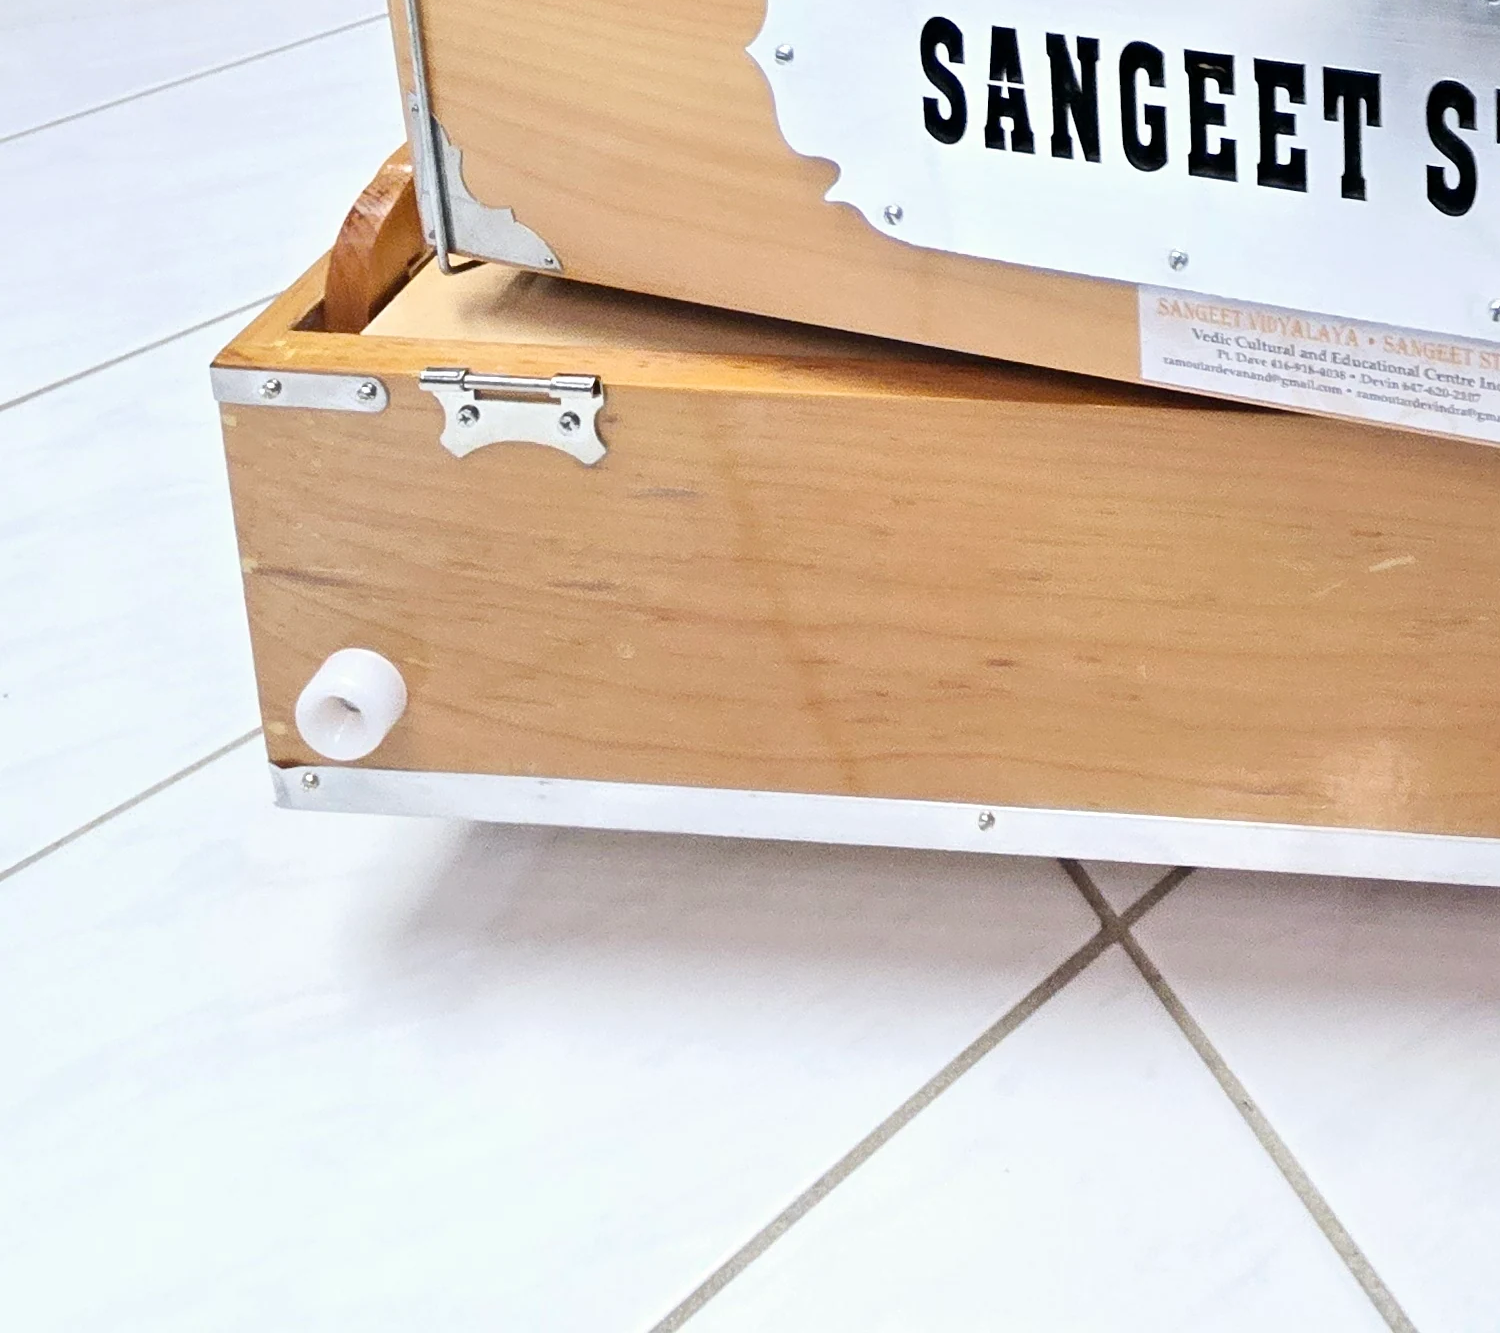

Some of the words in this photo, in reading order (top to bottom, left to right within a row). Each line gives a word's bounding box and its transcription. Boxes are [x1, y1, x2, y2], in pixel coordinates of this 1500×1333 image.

[921, 17, 1380, 201] SANGEET
[1156, 296, 1242, 329] SANGEET
[1247, 310, 1358, 348] VIDYALAYA
[1383, 334, 1473, 367] SANGEET
[1191, 327, 1231, 346] Vedic
[1235, 334, 1295, 357] Cultural
[1299, 346, 1326, 362] and
[1330, 351, 1419, 378] Educational
[1424, 367, 1475, 388] Centre
[1236, 352, 1267, 367] Dave
[1359, 373, 1398, 389] Devin
